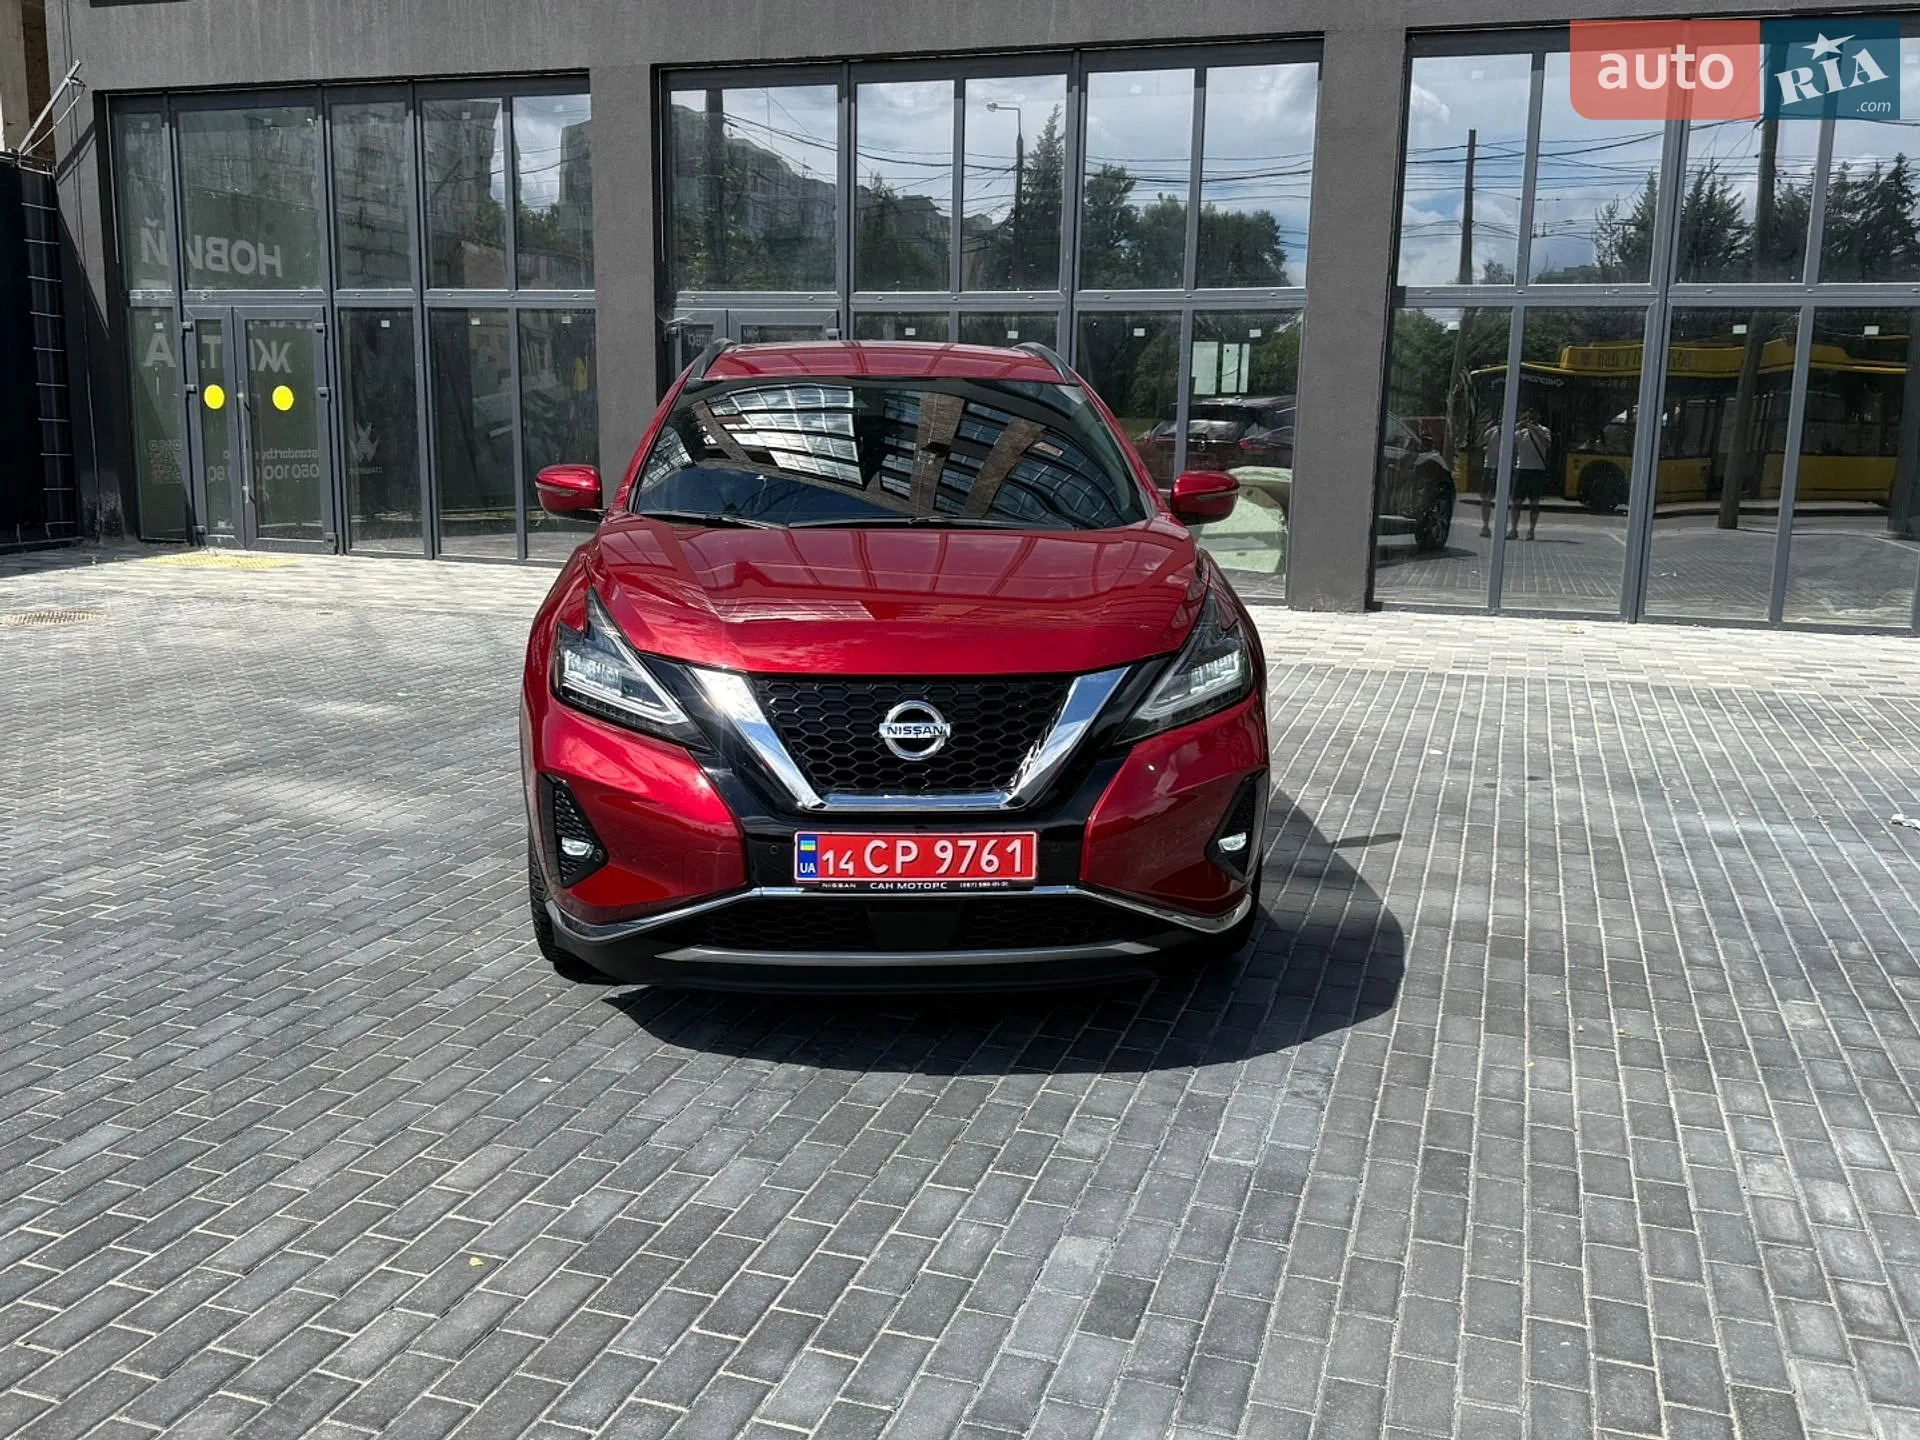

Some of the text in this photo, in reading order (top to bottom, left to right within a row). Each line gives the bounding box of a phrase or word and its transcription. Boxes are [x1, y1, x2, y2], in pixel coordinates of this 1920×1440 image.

[886, 725, 944, 735] NISSAN
[821, 839, 1022, 875] 14 CP 9761
[800, 862, 816, 874] UA
[896, 881, 948, 890] МОТОРС
